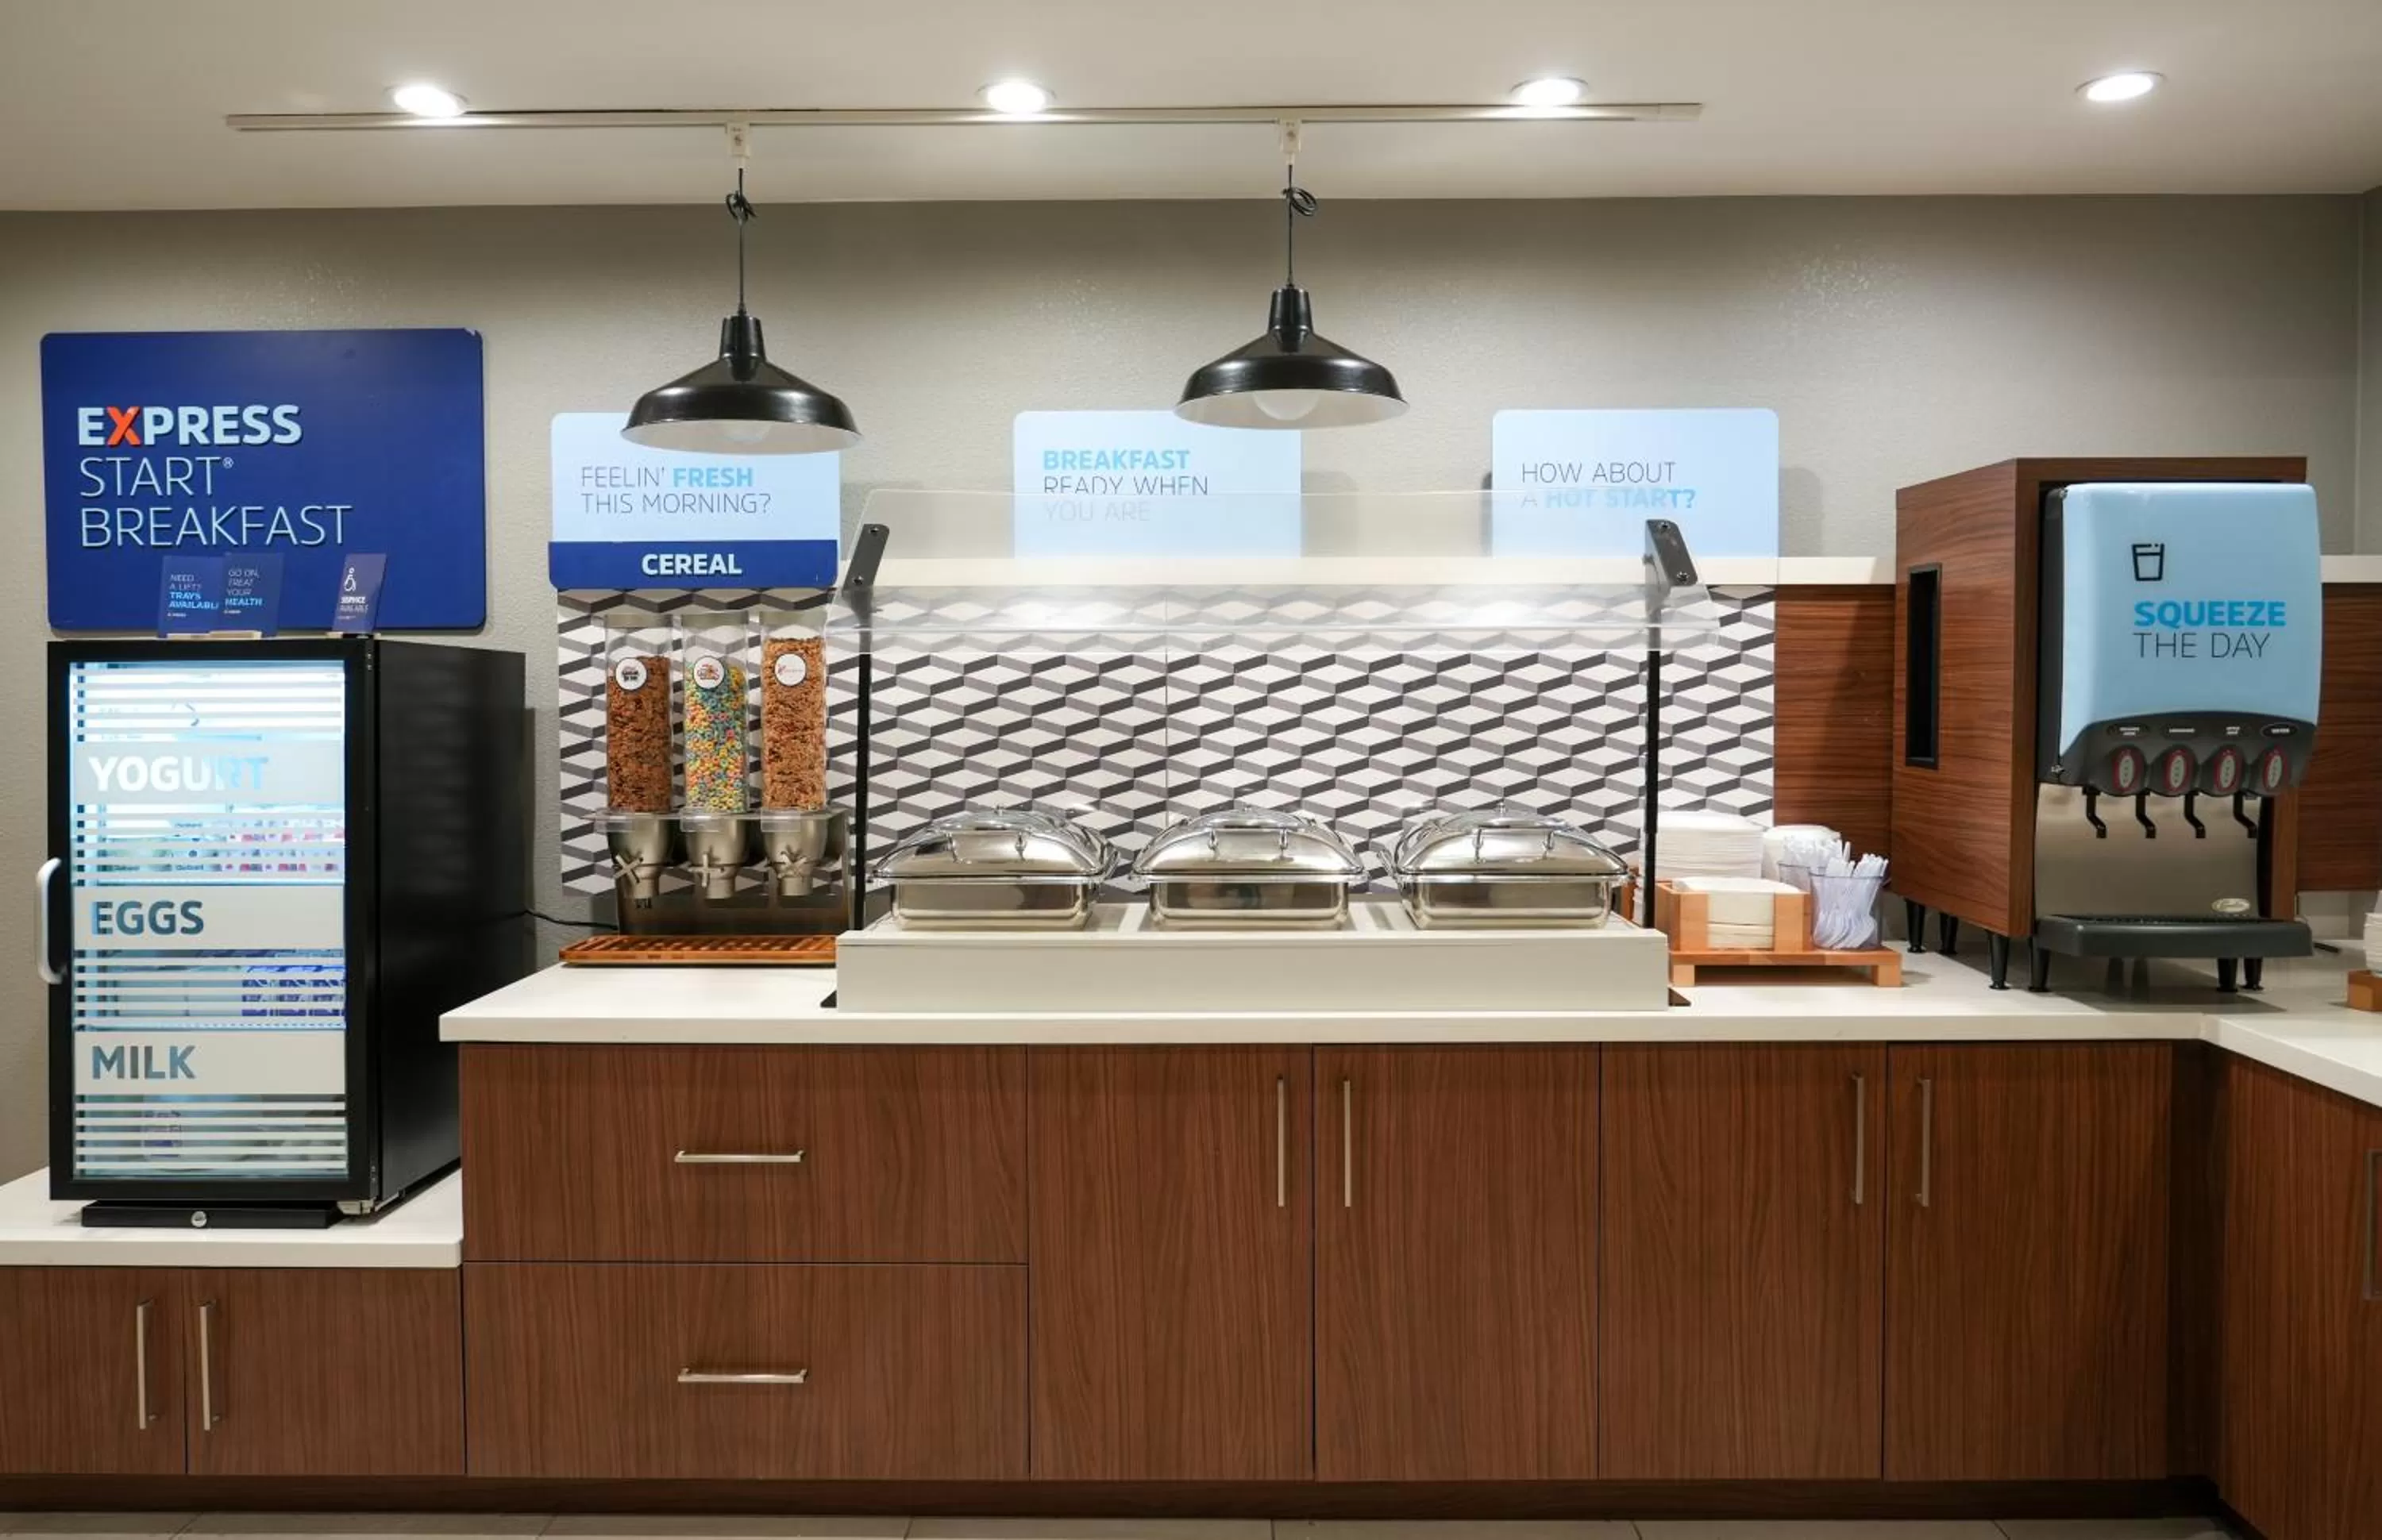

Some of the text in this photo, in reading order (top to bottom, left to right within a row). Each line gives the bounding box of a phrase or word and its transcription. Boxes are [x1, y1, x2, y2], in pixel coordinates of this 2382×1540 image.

[78, 404, 303, 446] EXPRESS
[1043, 449, 1190, 470] BREAKFAST
[581, 466, 754, 488] FEELIN' FRESH
[1522, 461, 1676, 483] HOW ABOUT
[1044, 475, 1208, 495] READY WHEN
[581, 492, 772, 514] THIS MORNING?
[1521, 488, 1697, 509] A HOT START?
[1045, 501, 1151, 522] YOU ARE
[80, 505, 353, 548] BREAKFAST
[642, 553, 742, 576] CEREAL
[169, 591, 202, 600] TRAYS
[2133, 601, 2286, 629] SQUEEZE
[2133, 633, 2271, 658] THE DAY
[88, 755, 268, 791] YOGURT
[92, 900, 204, 935] EGGS
[92, 1045, 196, 1080] MILK
